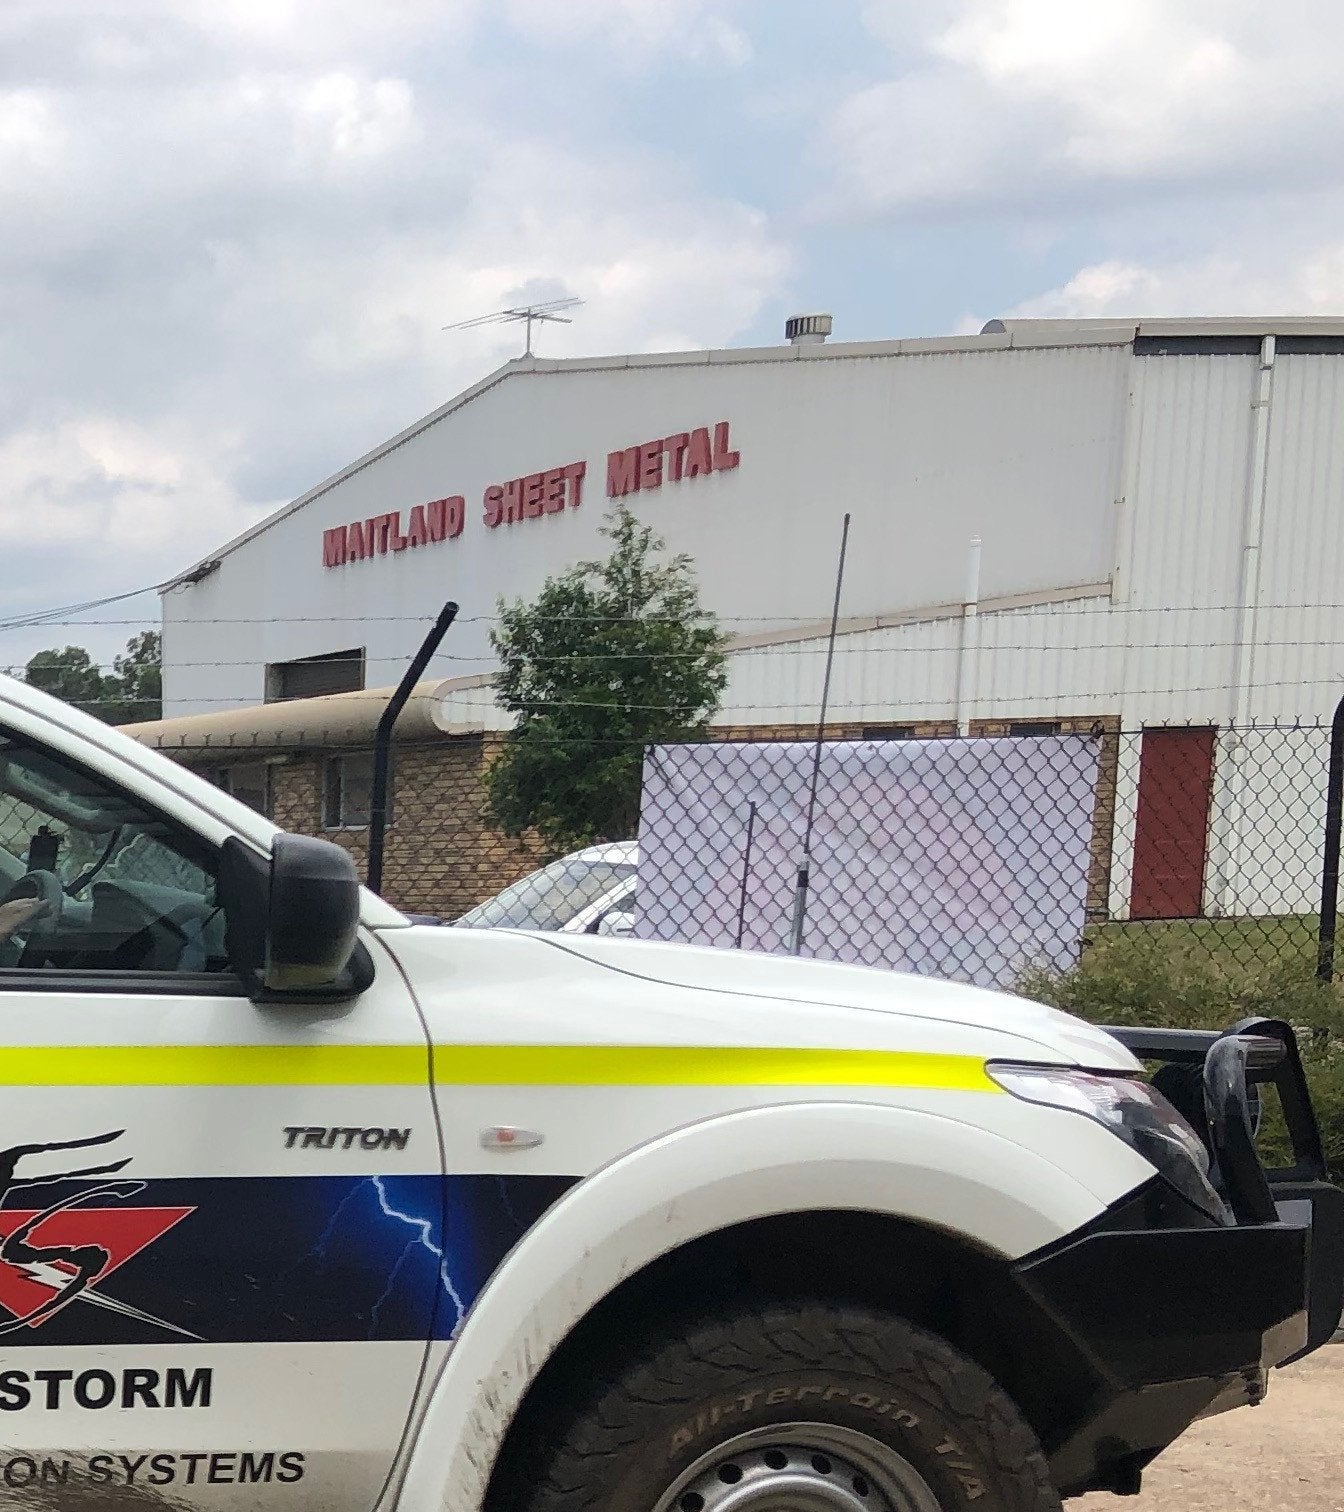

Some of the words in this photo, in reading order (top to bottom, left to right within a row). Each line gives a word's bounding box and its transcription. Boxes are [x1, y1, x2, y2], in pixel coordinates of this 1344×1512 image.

[322, 495, 466, 567] MAITLAND
[483, 461, 587, 529] SHEET
[606, 421, 740, 498] METAL
[282, 1126, 413, 1150] TRITON
[87, 1451, 306, 1488] SYSTEMS
[670, 1384, 919, 1450] All-Terrain
[934, 1435, 987, 1500] T/A
